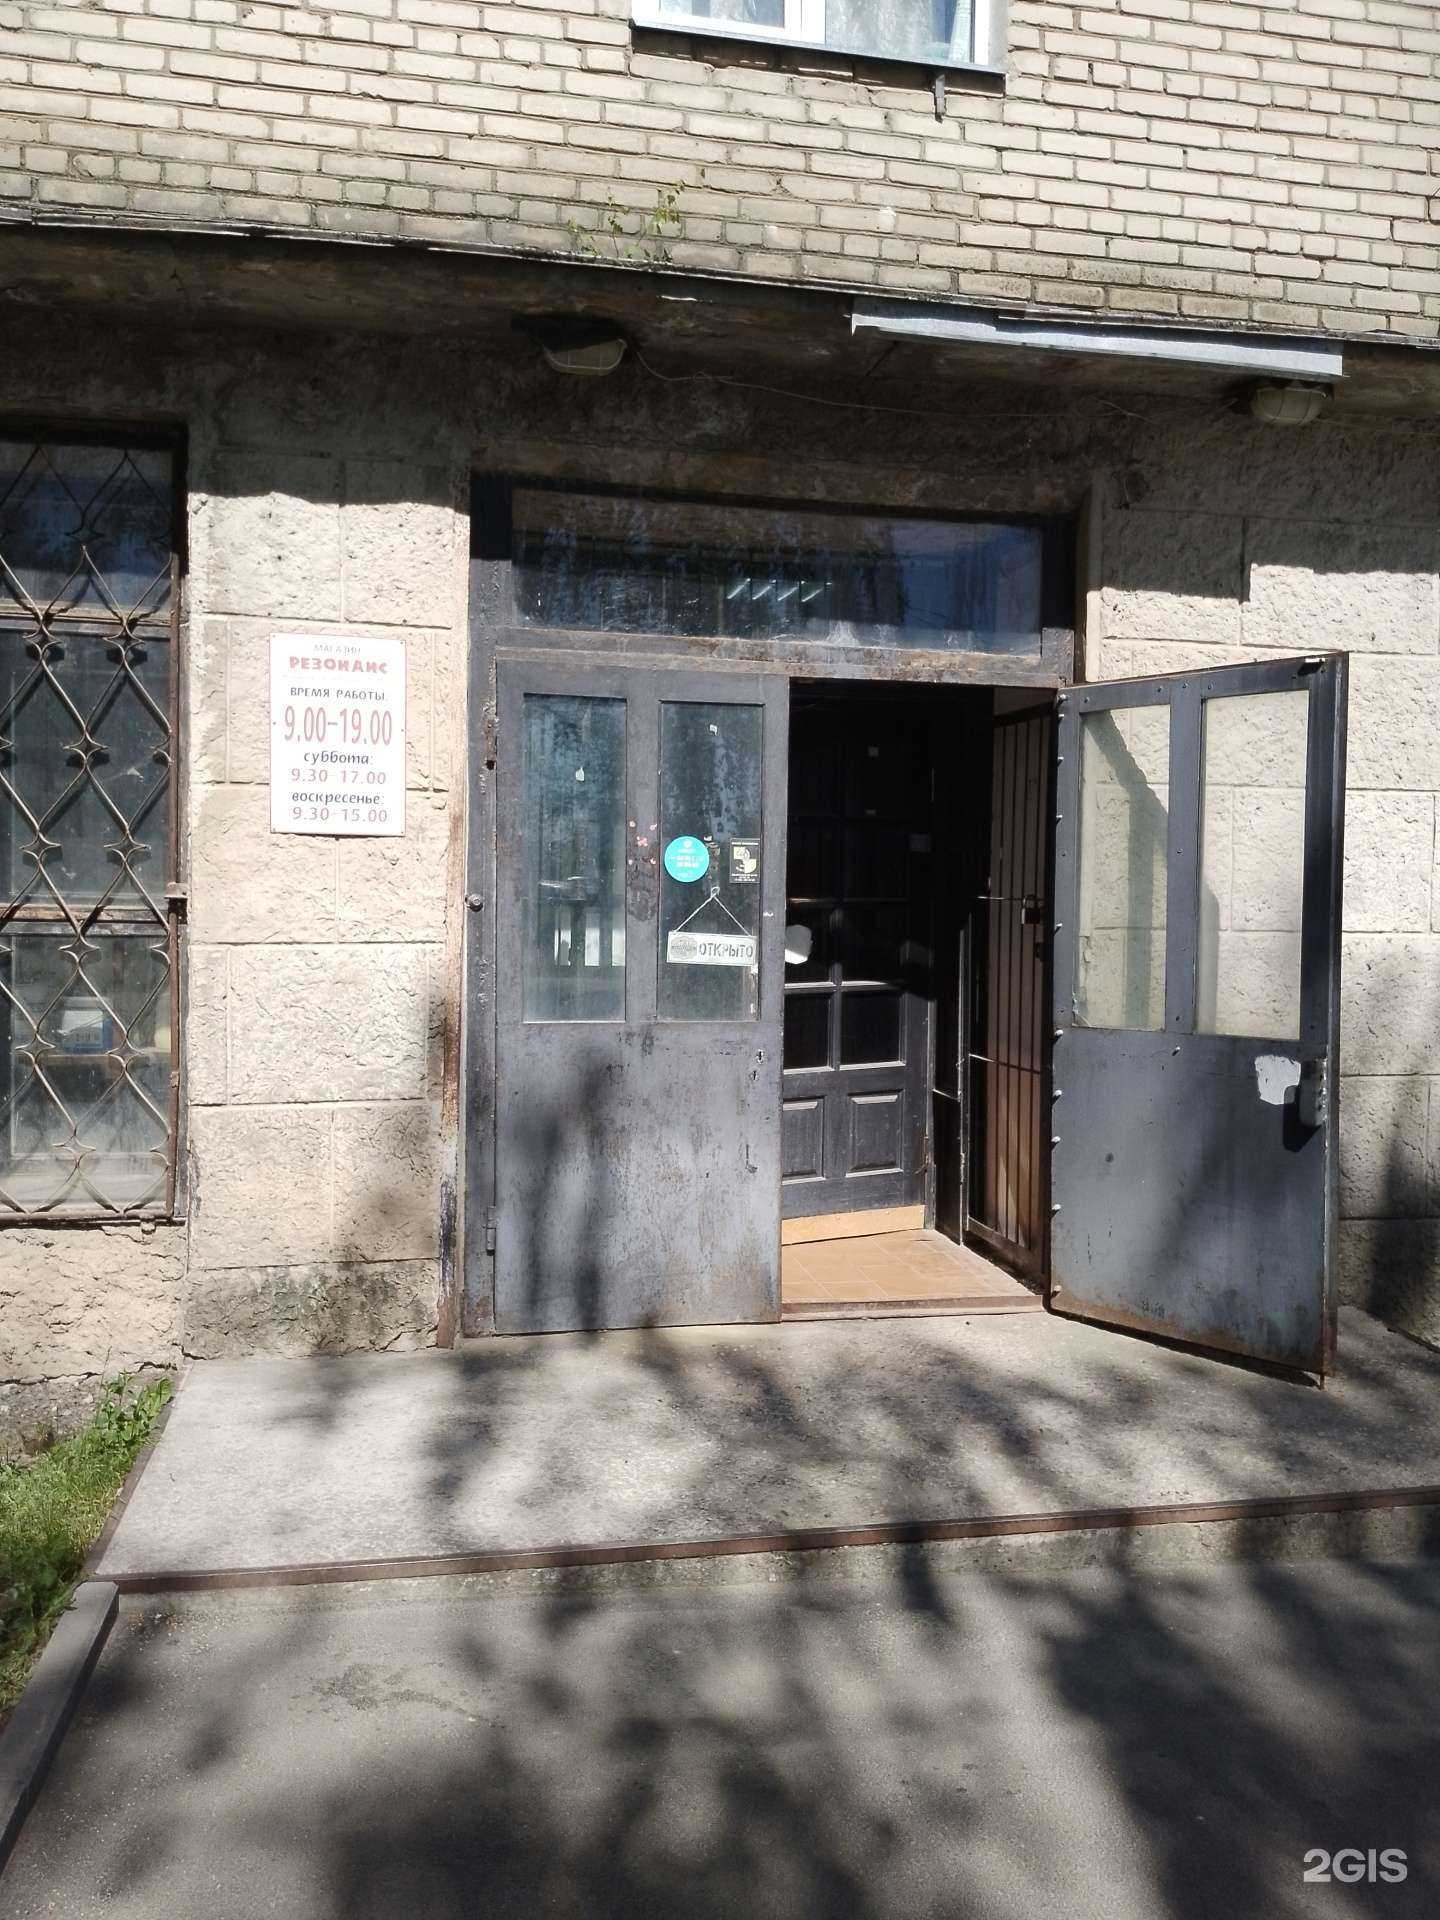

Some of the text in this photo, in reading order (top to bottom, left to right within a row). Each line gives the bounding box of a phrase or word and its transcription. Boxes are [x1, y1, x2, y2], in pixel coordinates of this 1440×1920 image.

[289, 656, 388, 674] РЕЗОНАНС
[290, 687, 330, 698] ВРЕМЯ
[699, 942, 754, 957] ОТКРЫТО
